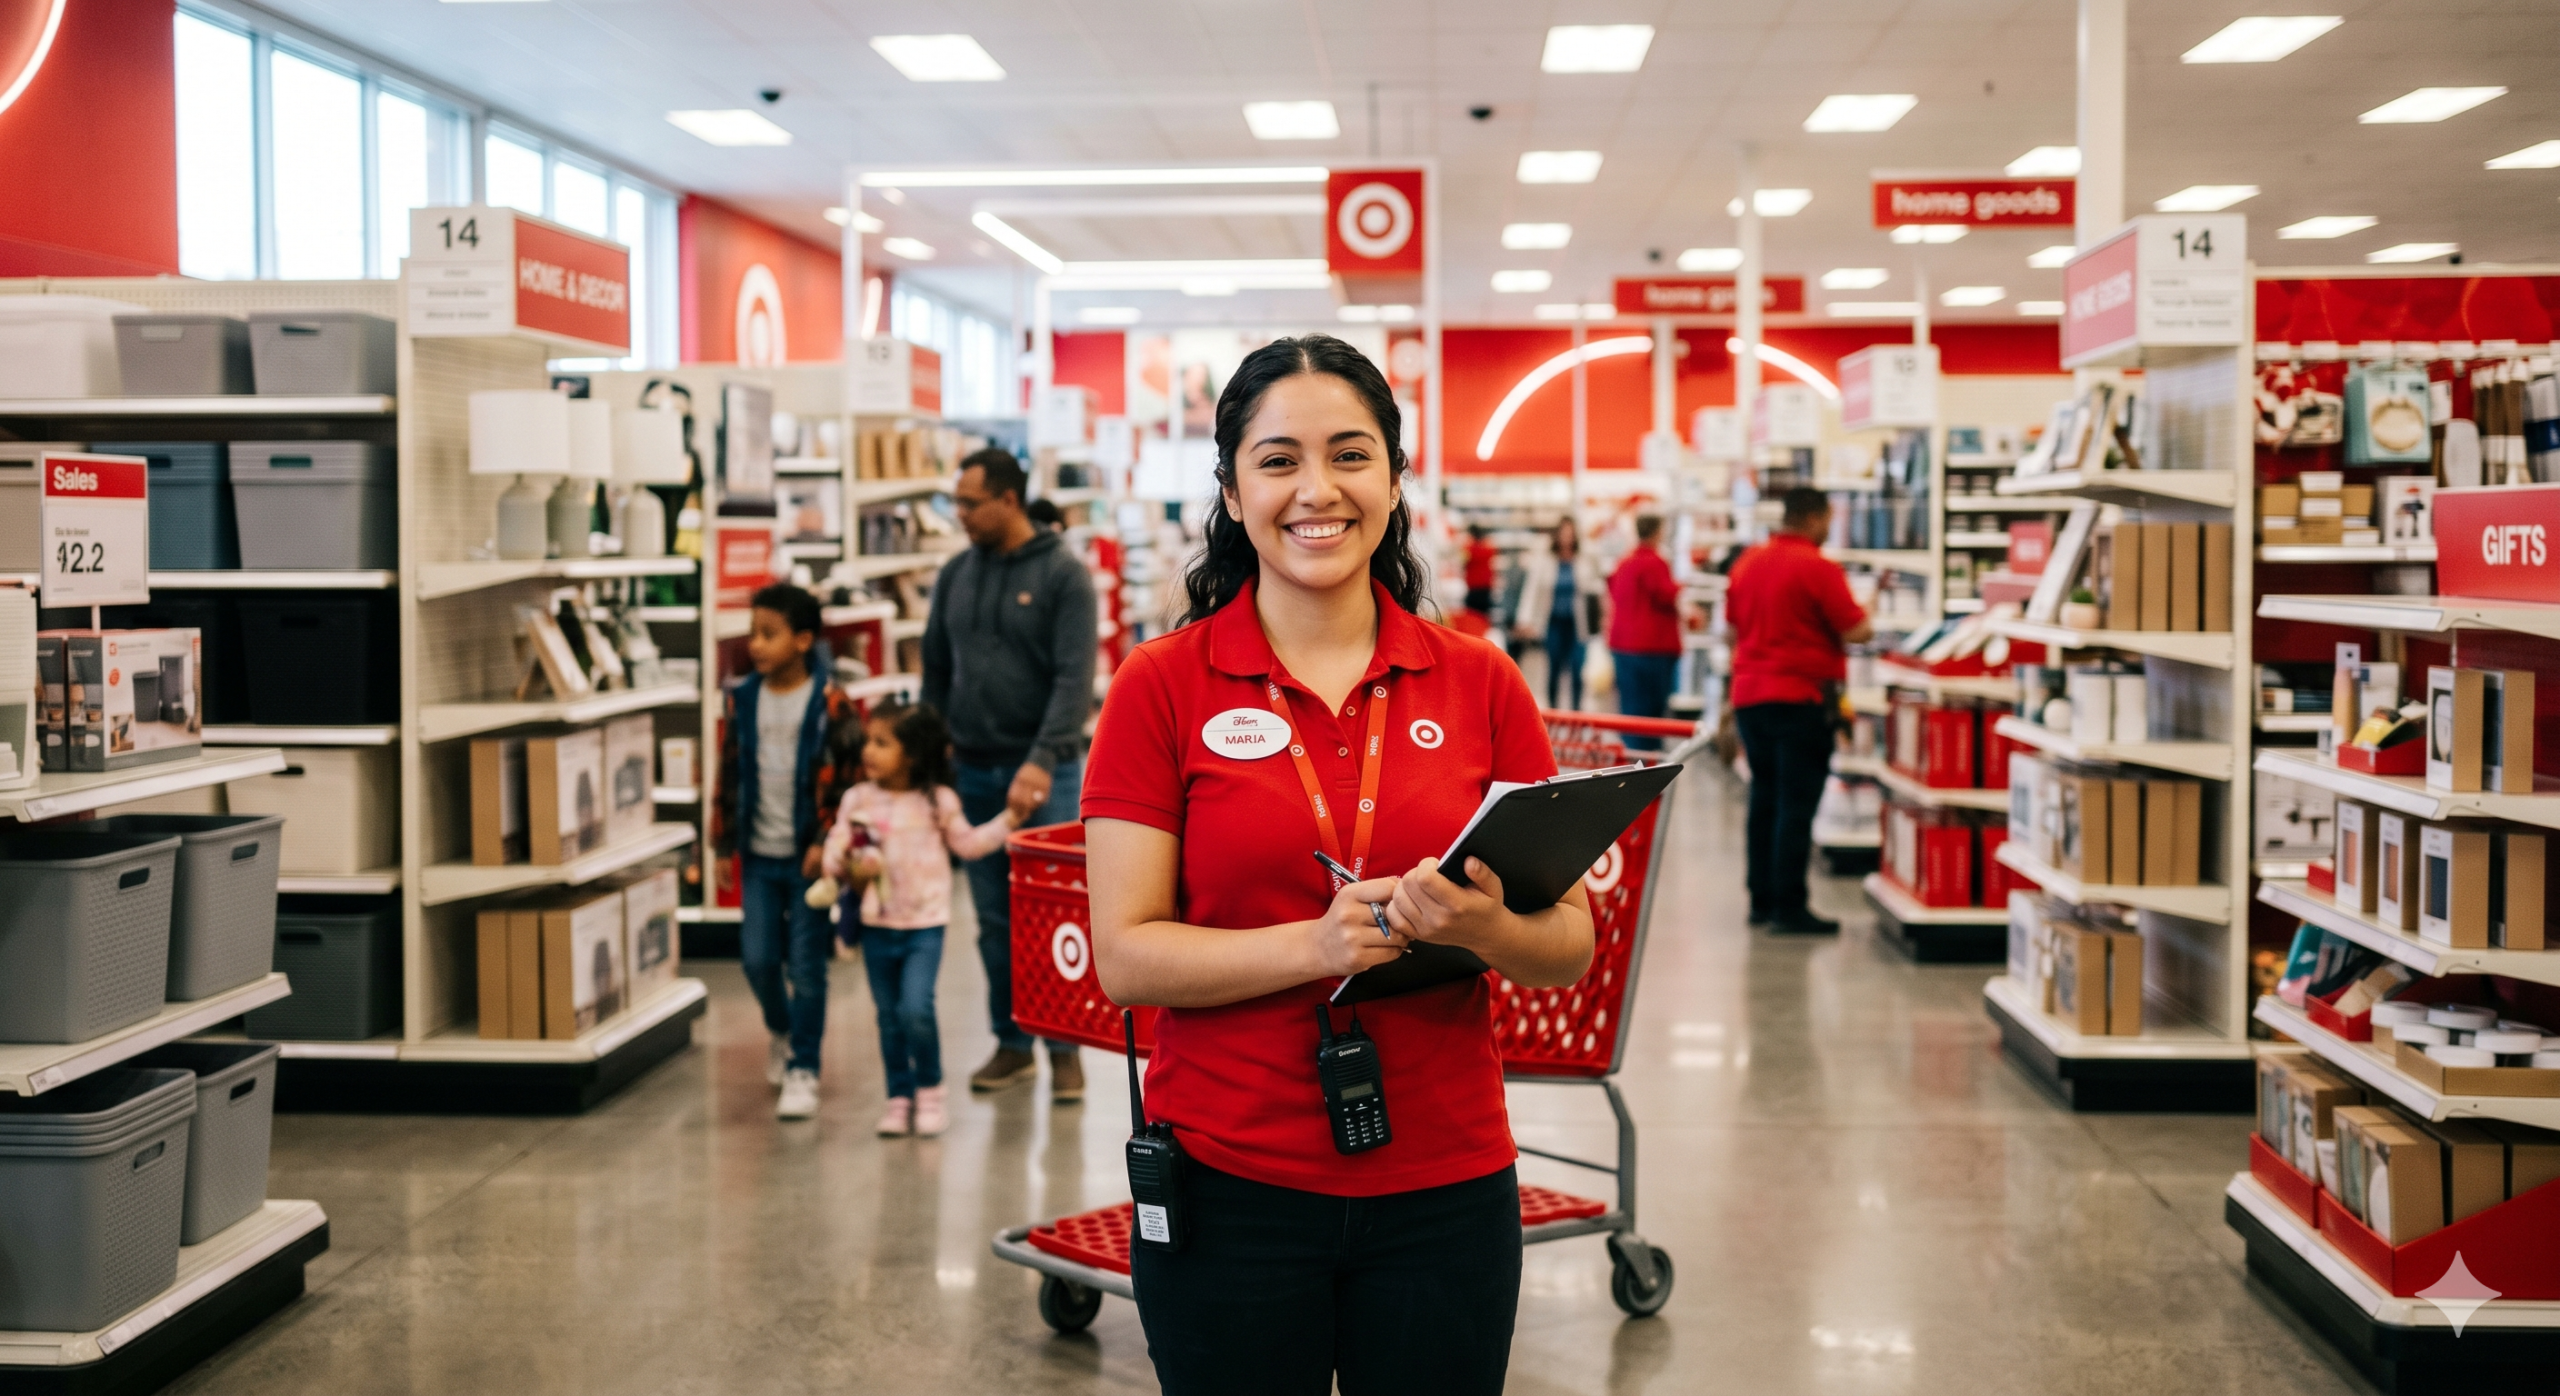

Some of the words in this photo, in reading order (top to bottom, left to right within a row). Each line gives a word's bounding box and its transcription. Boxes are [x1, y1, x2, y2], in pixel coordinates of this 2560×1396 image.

[1891, 187, 1970, 216] home
[1974, 186, 2061, 220] goods
[438, 217, 480, 248] 14
[2173, 229, 2213, 259] 14
[53, 465, 98, 491] Sales
[2482, 524, 2547, 566] GIFTS
[1225, 734, 1266, 745] MARIA
